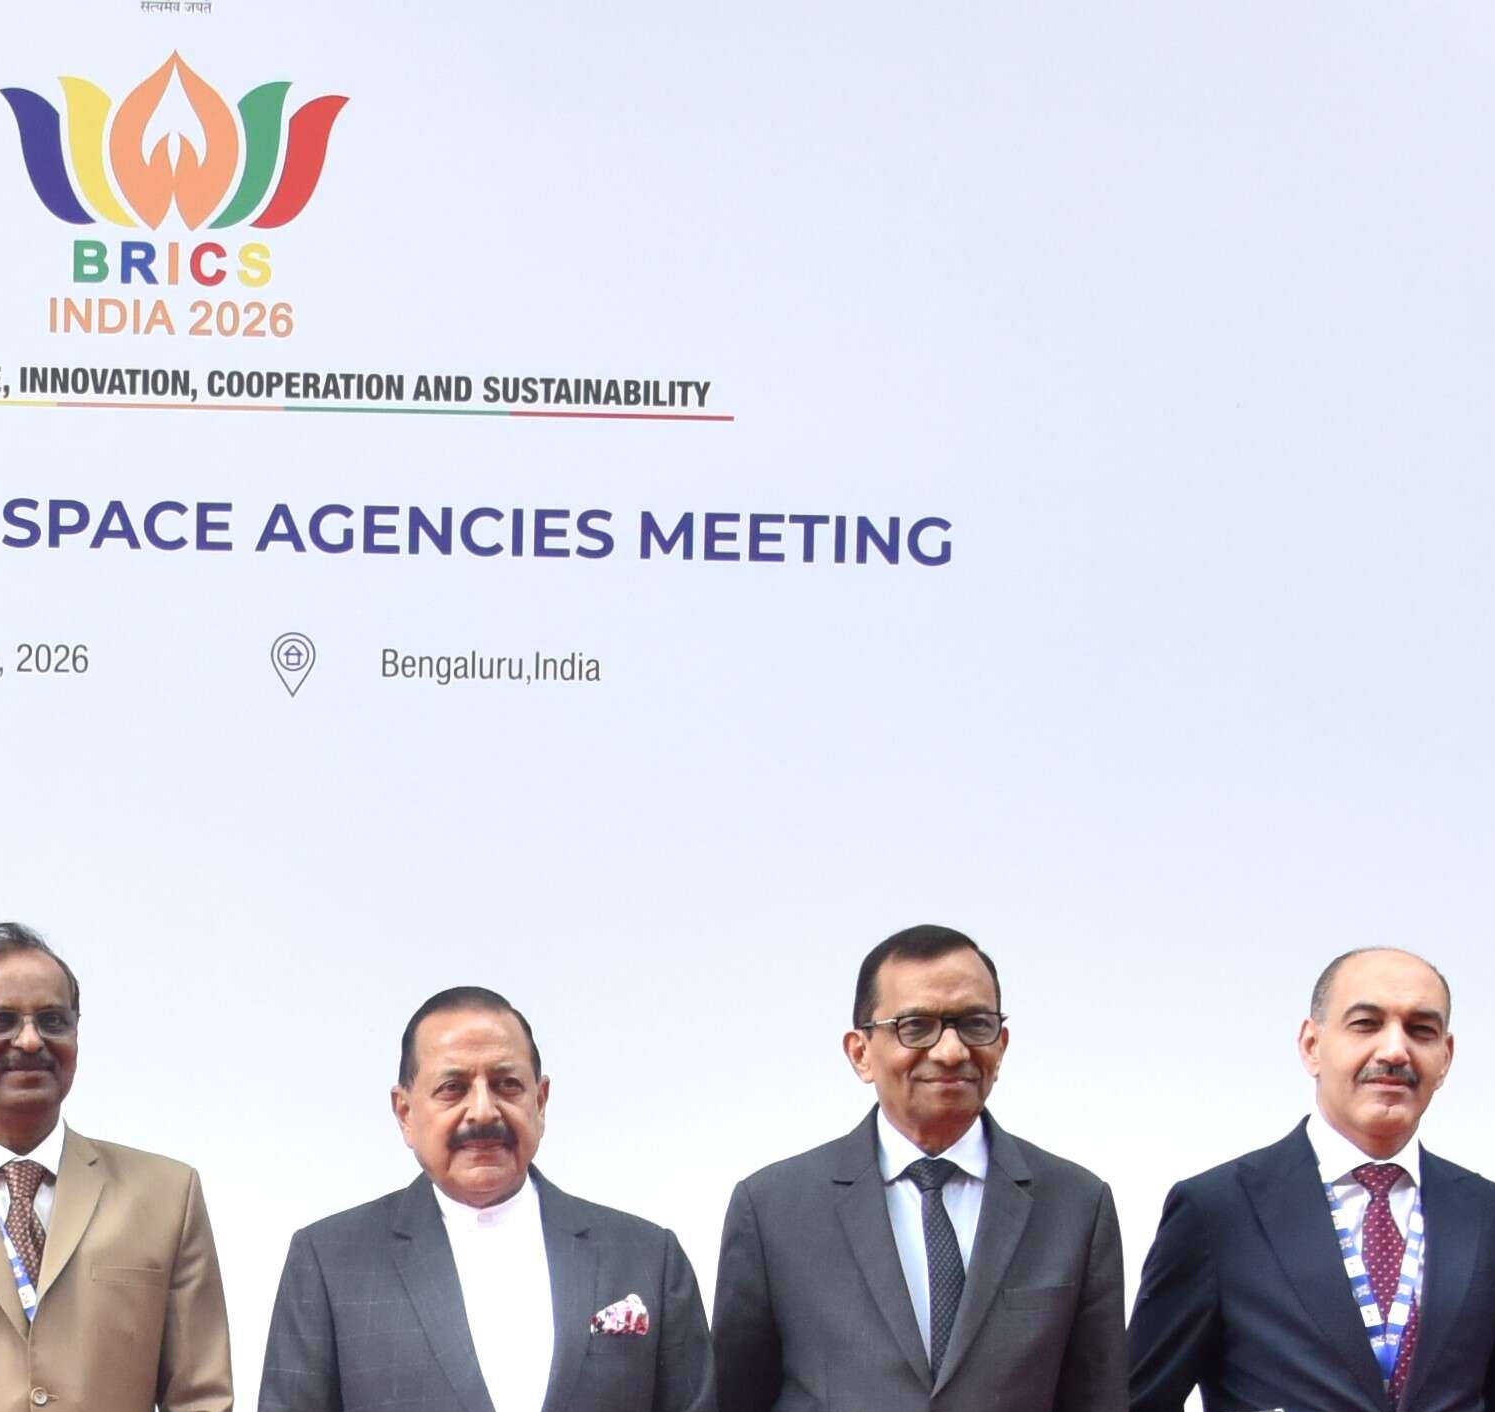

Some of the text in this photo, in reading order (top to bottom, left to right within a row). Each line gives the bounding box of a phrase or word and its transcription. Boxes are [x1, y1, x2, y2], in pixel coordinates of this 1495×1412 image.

[140, 0, 212, 14] सत्यमव जयत
[72, 239, 273, 289] BRICS
[49, 297, 294, 338] INDIA 2026
[19, 366, 198, 402] INNOVATION,
[207, 370, 404, 401] COOPERATION
[412, 375, 472, 402] AND
[482, 376, 711, 407] SUSTAINABILITY
[1, 497, 233, 552] SPACE
[254, 503, 615, 560] AGENCIES
[639, 510, 953, 567] MEETING
[16, 643, 89, 674] 2026
[381, 648, 601, 686] Bengaluru,India
